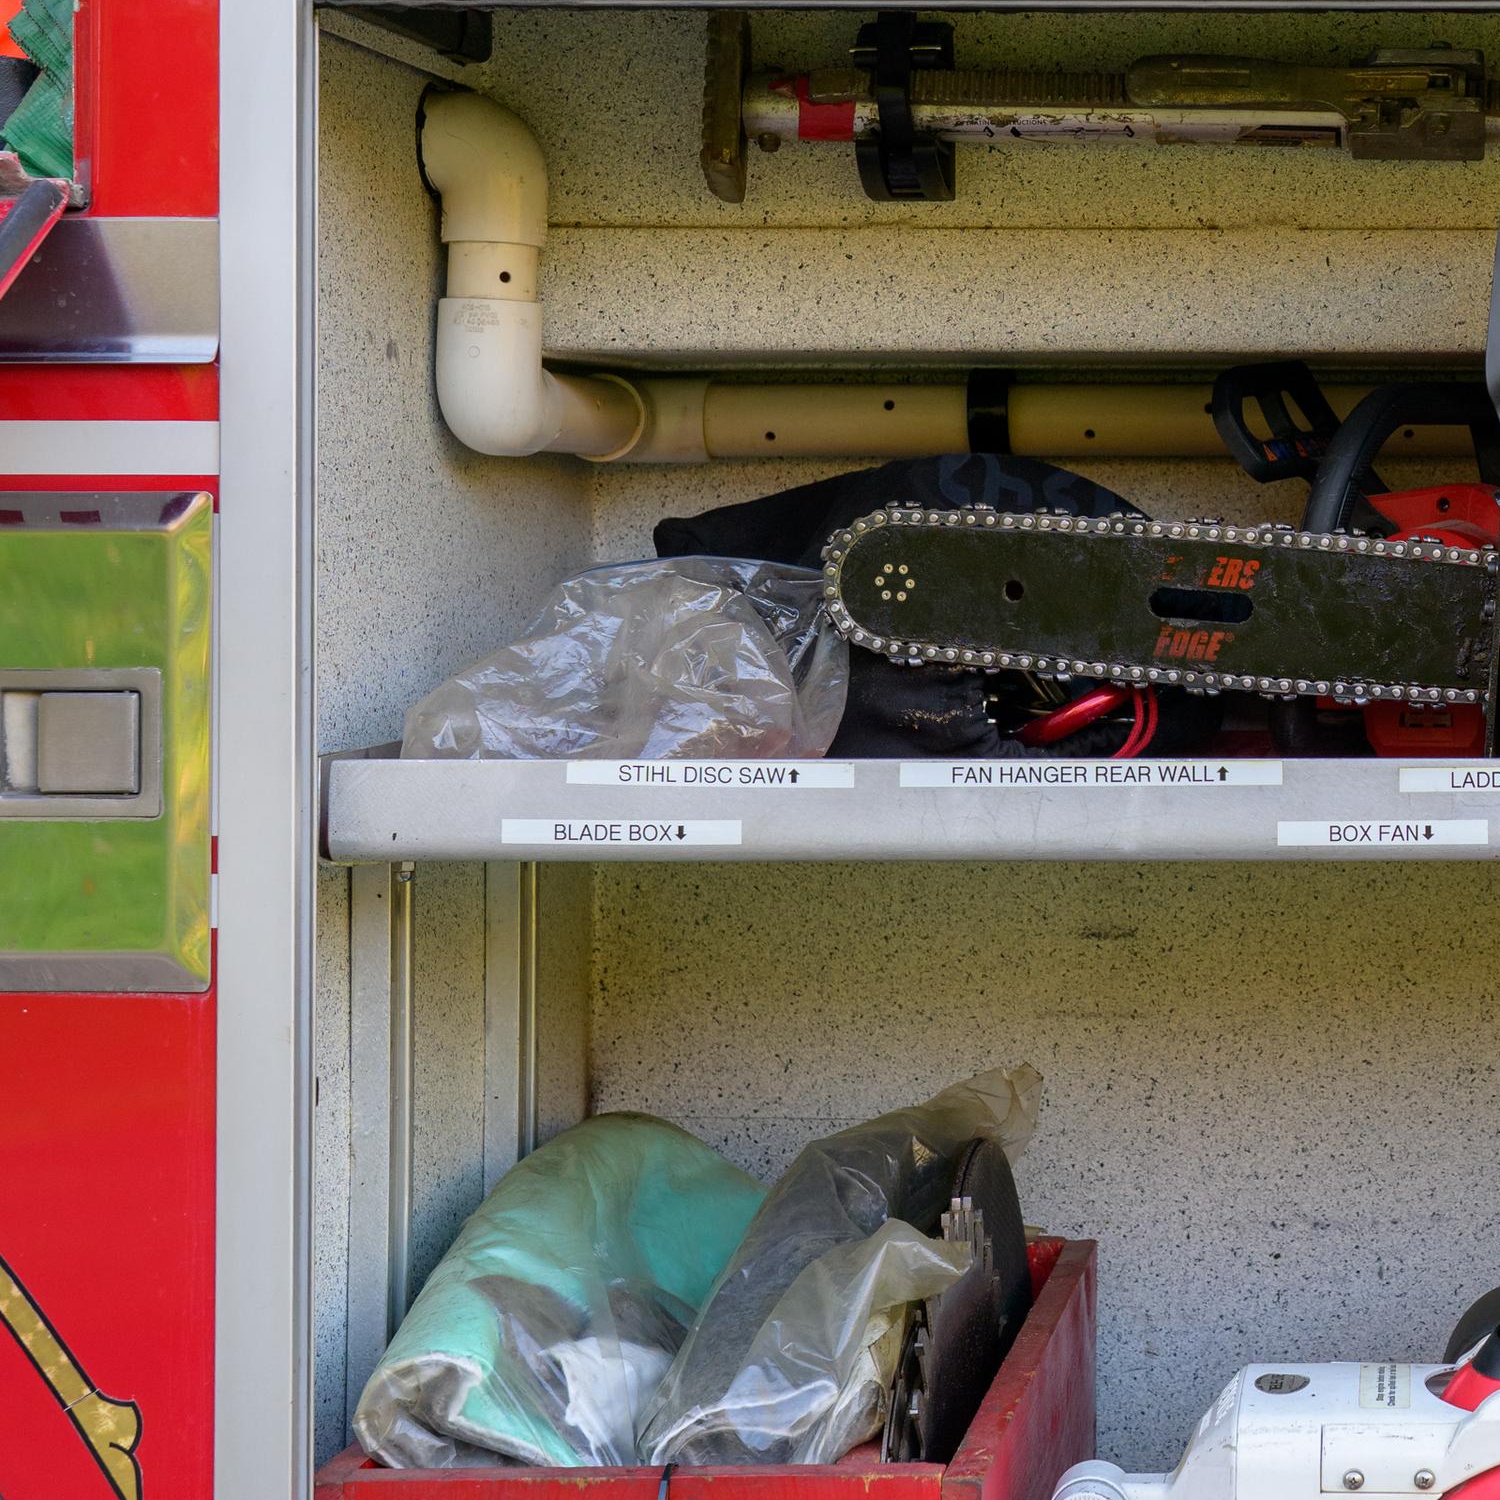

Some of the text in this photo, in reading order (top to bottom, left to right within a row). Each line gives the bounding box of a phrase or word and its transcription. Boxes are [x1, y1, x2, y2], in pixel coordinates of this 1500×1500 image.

[618, 765, 786, 784] STIHL DISC SAW
[952, 765, 1213, 784] FAN HANGER REAR WALL
[554, 824, 672, 841] BLADE BOX
[1329, 824, 1419, 842] BOX FAN
